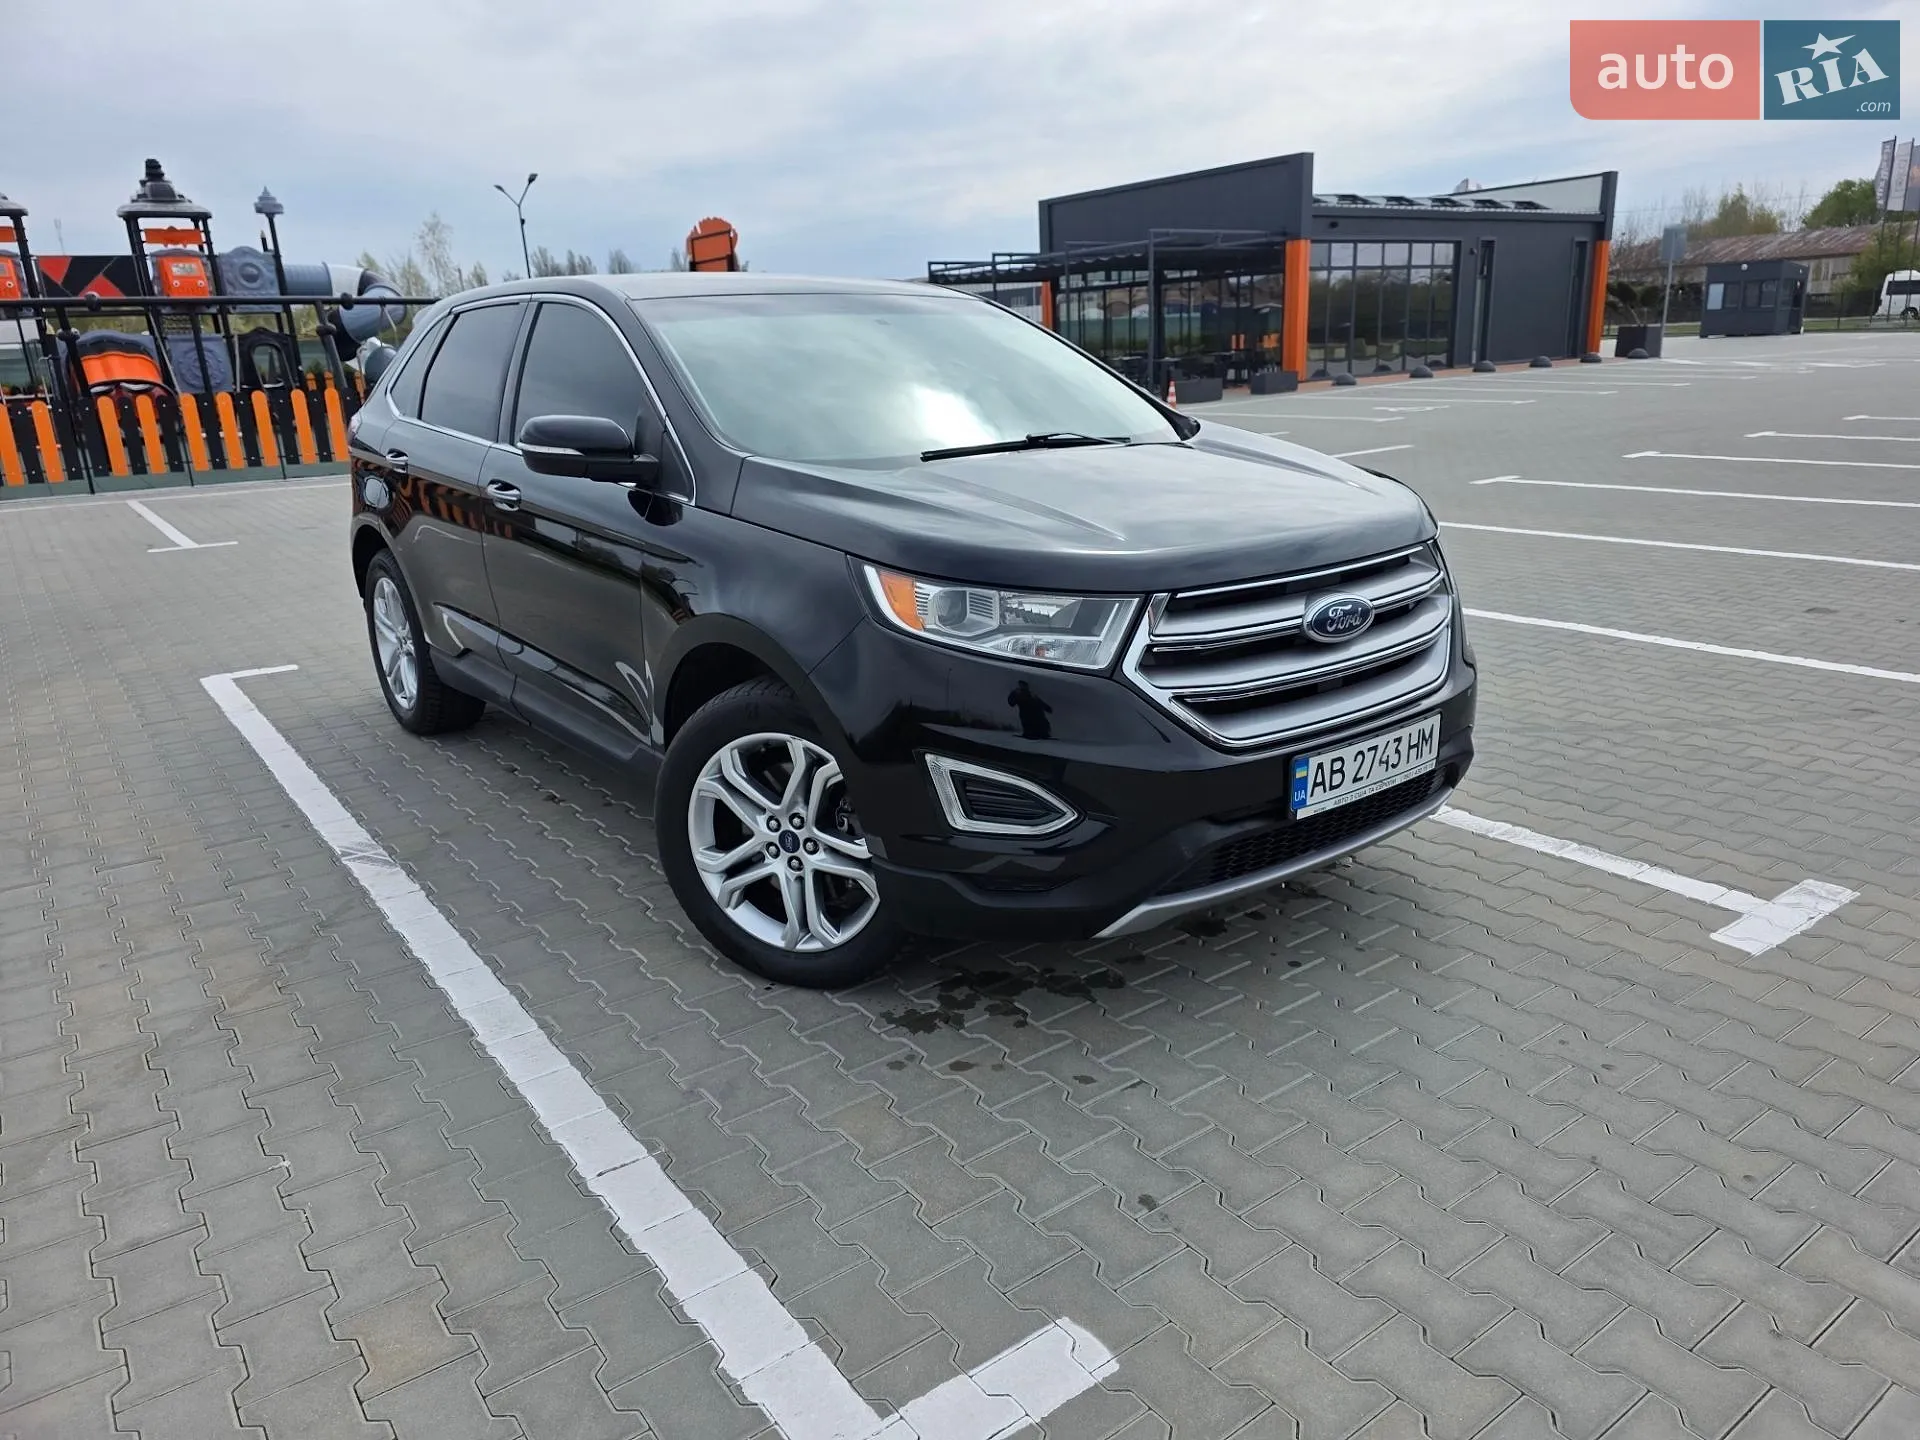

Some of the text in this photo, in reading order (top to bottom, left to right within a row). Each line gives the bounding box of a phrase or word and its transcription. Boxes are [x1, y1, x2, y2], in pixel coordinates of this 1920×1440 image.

[1326, 604, 1362, 632] Ford
[1310, 756, 1346, 797] AB
[1352, 736, 1402, 784] 2743
[1406, 724, 1434, 764] HM
[1294, 790, 1306, 801] UA
